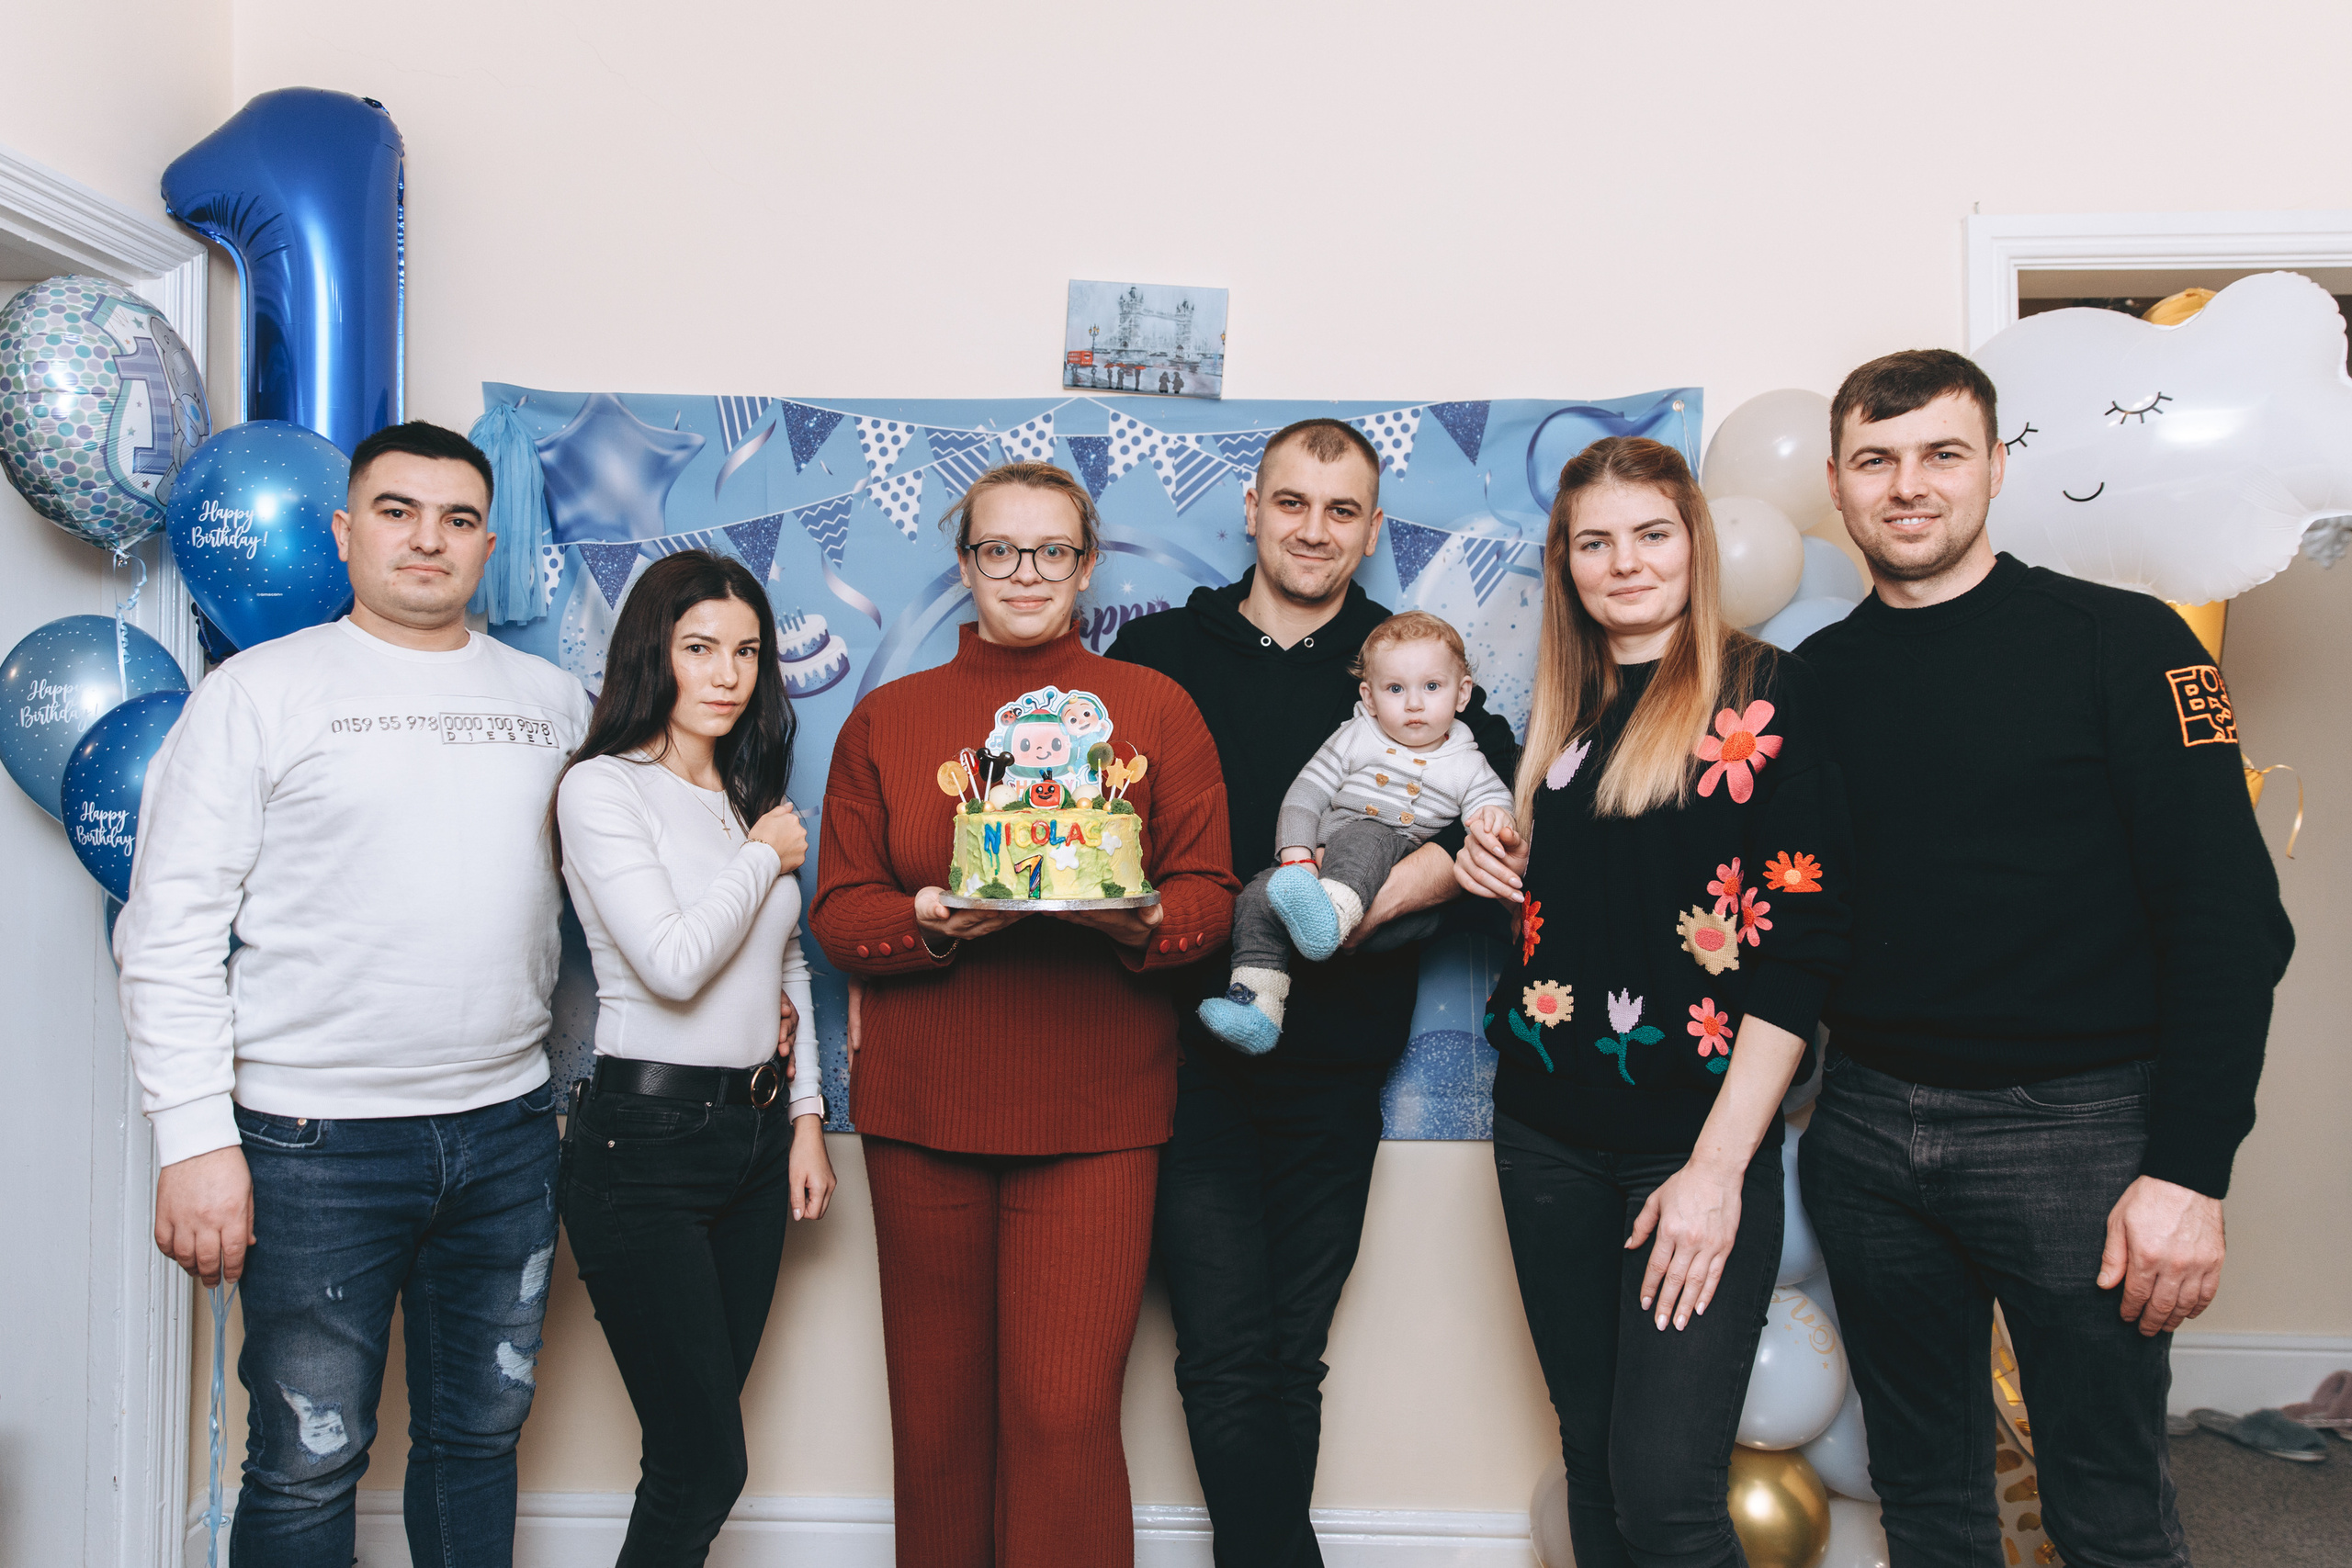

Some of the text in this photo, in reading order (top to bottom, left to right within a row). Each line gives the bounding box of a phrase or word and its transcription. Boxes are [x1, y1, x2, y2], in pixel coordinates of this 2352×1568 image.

[198, 500, 257, 534] Happy
[331, 716, 551, 736] 0159 55 978 0000 100 9078
[447, 730, 553, 745] DIESEL
[80, 800, 130, 834] Happy
[75, 825, 136, 858] Birthday
[984, 819, 1103, 855] NICOLAS
